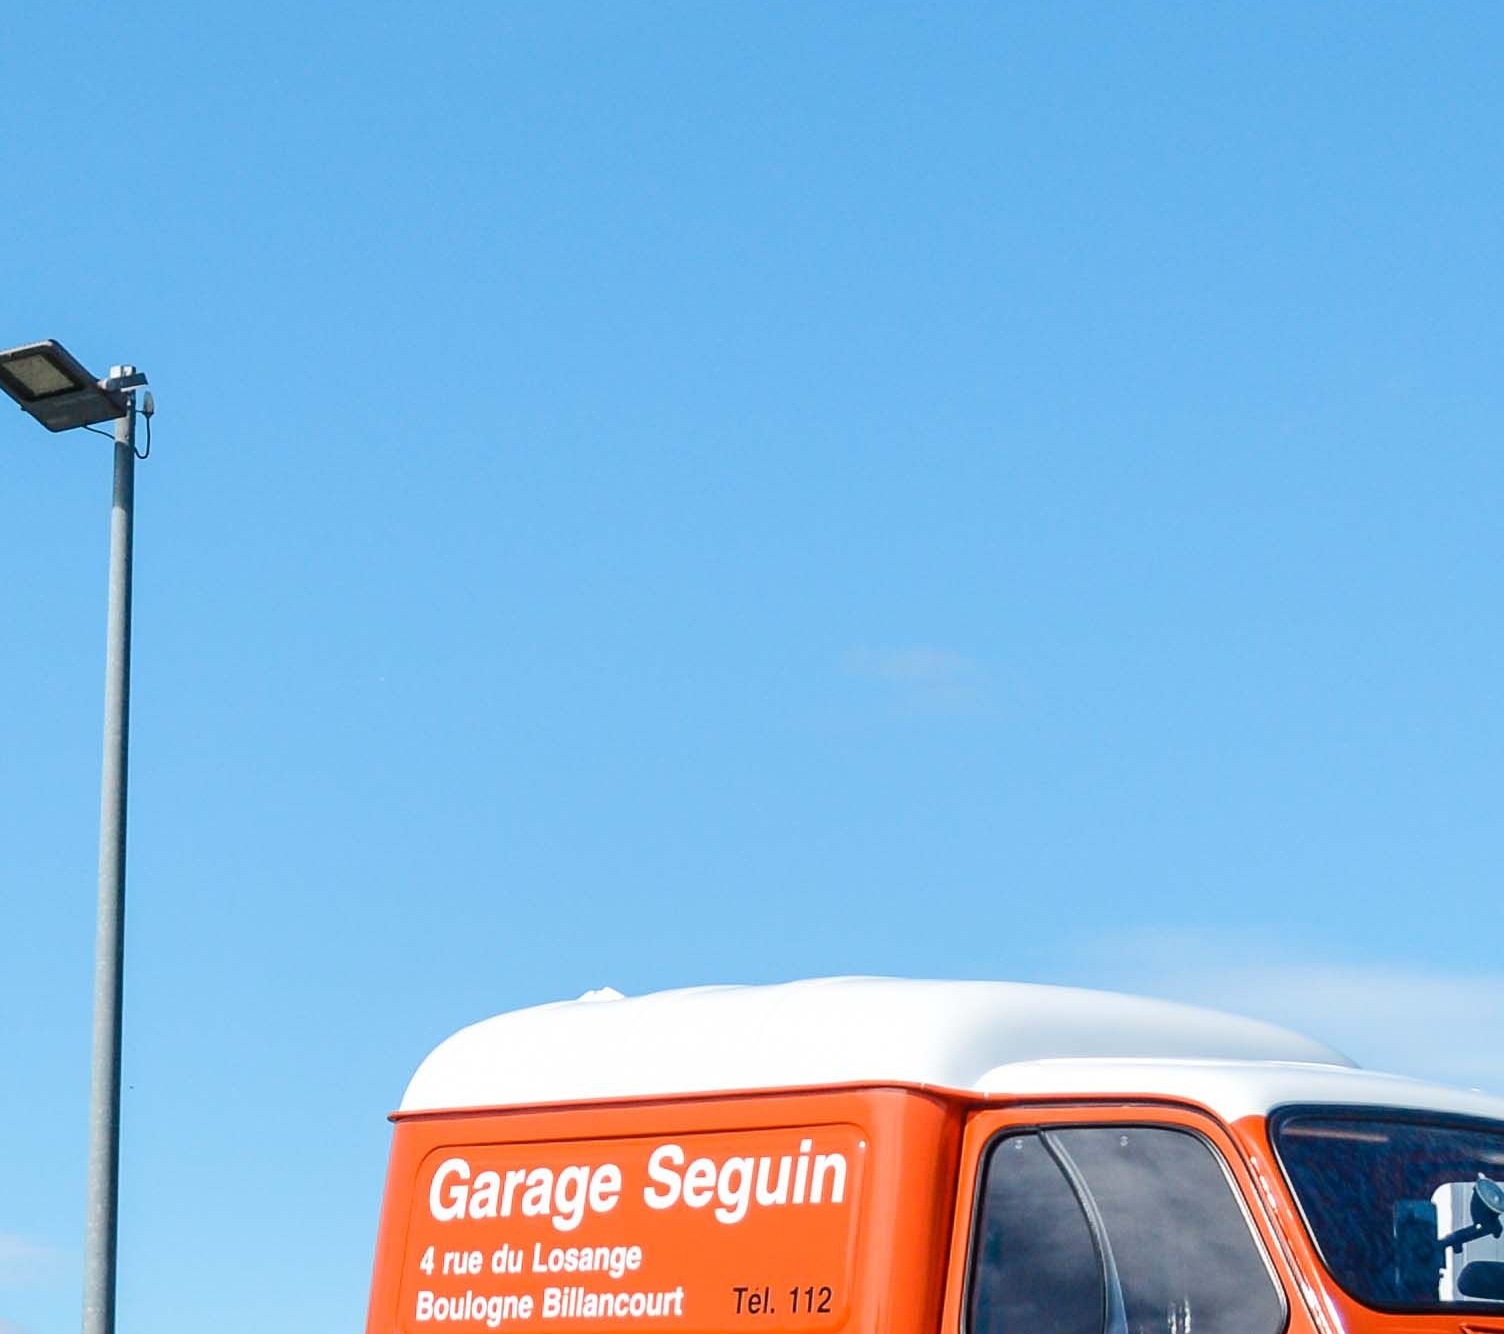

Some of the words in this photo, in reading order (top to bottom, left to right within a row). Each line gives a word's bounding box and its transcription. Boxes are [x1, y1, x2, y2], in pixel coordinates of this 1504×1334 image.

[429, 1157, 622, 1231] Garage
[643, 1139, 847, 1224] Seguin
[419, 1245, 435, 1275] 4
[442, 1250, 484, 1275] rue
[491, 1243, 524, 1274] du
[532, 1242, 643, 1278] Losange
[415, 1290, 534, 1327] Boulogne
[542, 1285, 684, 1318] Billancourt
[733, 1286, 775, 1314] Tél.
[789, 1286, 832, 1313] 112
